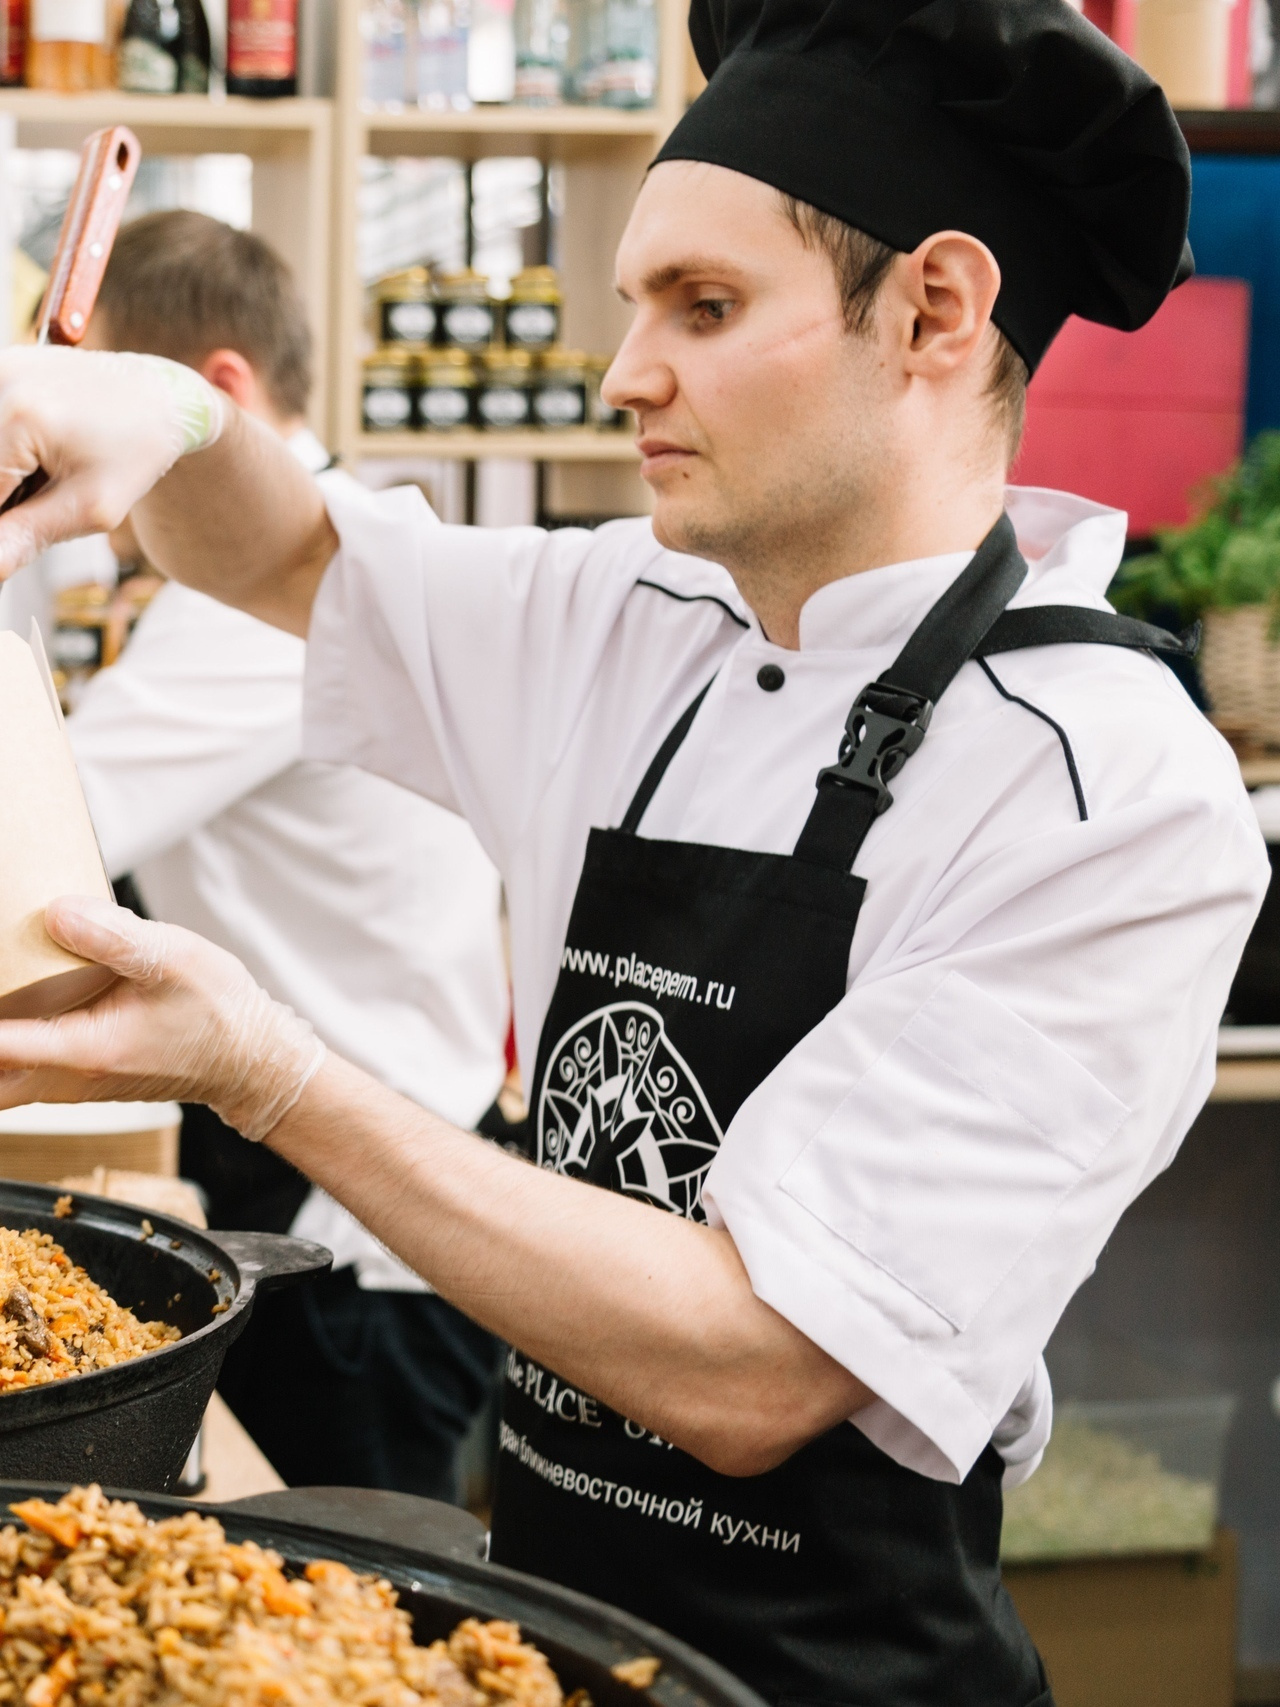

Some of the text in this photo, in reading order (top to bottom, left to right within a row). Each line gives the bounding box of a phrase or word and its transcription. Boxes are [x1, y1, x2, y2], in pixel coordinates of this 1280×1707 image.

[524, 1362, 603, 1428] PLACE
[519, 1434, 703, 1529] ближневосточной
[710, 1511, 801, 1554] кухни
